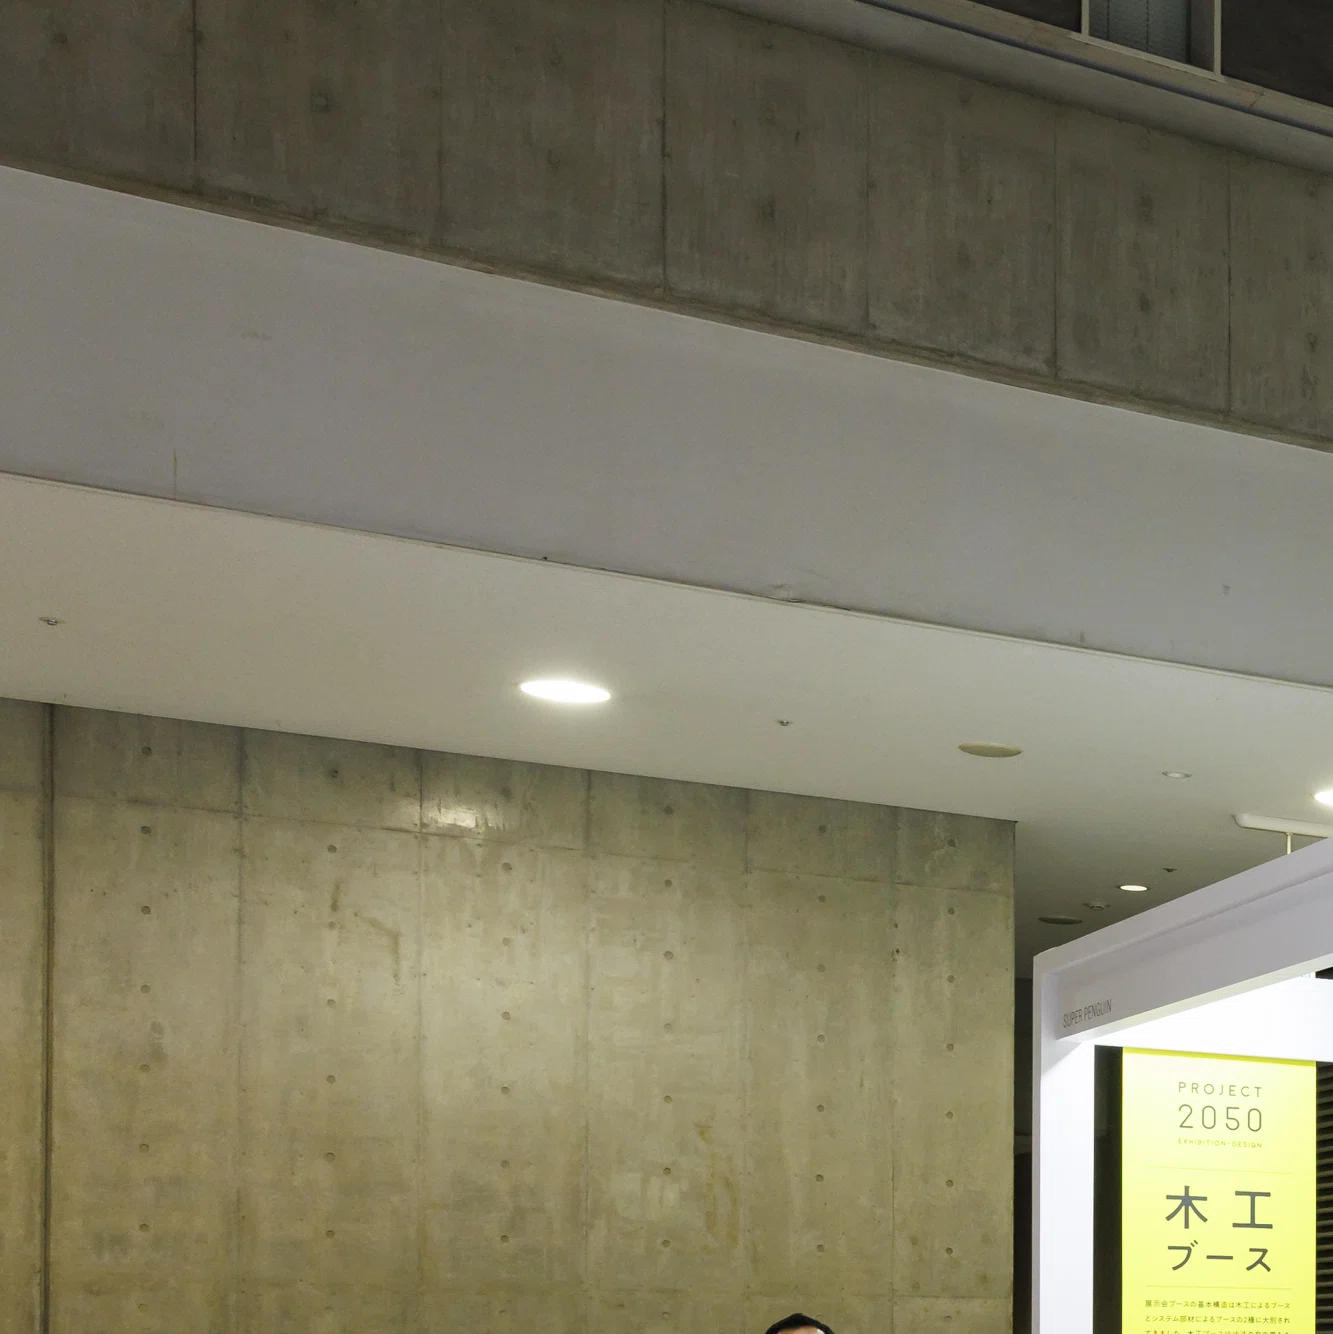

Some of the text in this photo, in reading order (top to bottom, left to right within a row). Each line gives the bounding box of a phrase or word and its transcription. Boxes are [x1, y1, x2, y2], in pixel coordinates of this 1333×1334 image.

[1062, 999, 1112, 1029] SUPER PENGUIN
[1178, 1081, 1263, 1098] PROJECT
[1178, 1103, 1262, 1133] 2050
[1177, 1137, 1263, 1149] EXHIBITION-DESIGN
[1165, 1185, 1273, 1229] 木工
[1167, 1239, 1271, 1272] ブース
